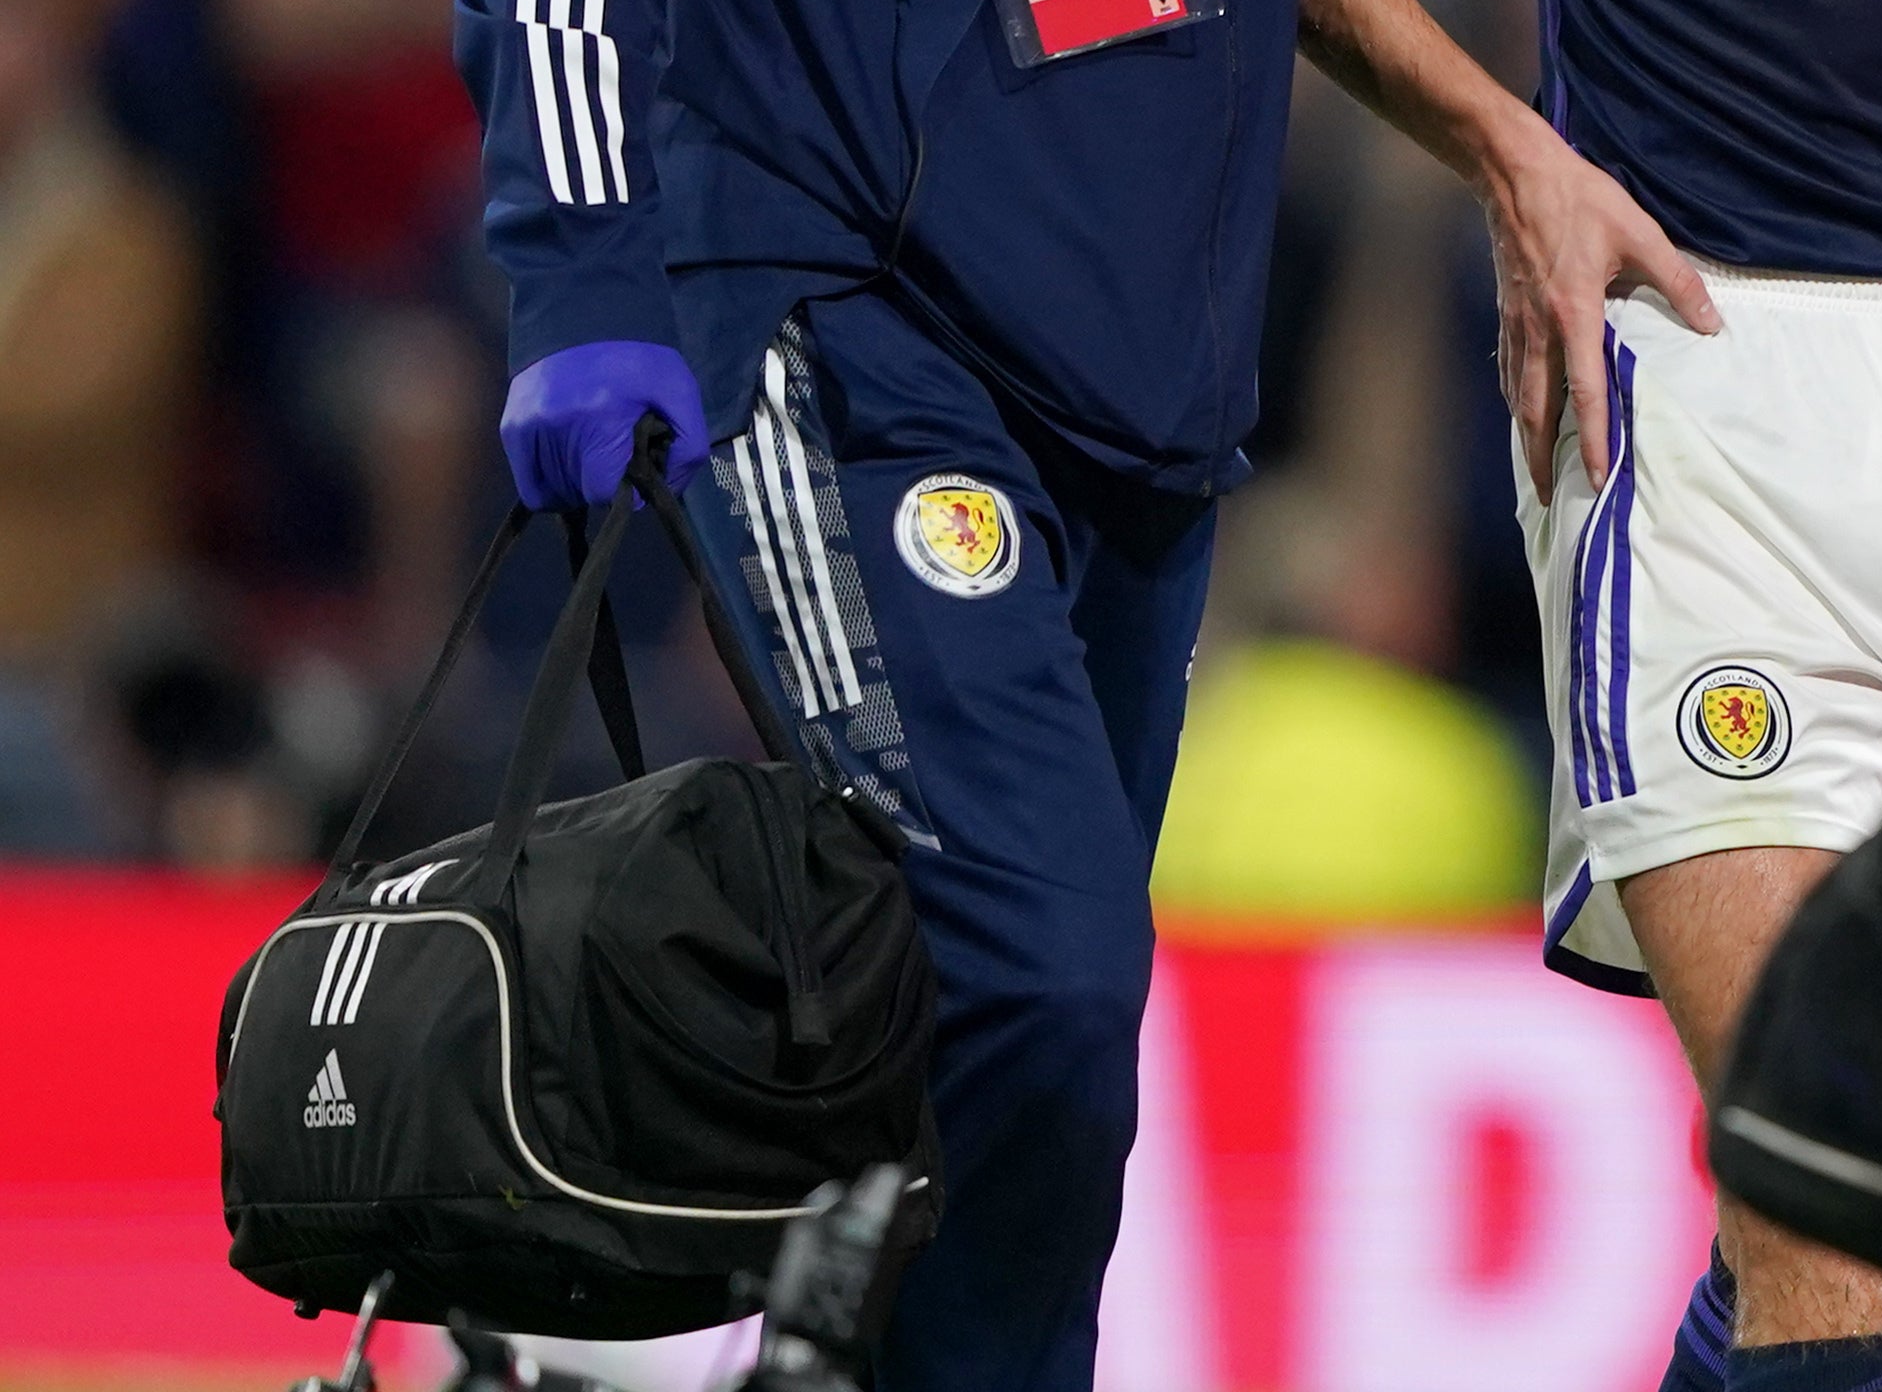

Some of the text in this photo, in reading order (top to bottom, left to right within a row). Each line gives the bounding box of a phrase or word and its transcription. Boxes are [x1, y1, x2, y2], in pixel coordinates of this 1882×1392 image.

[922, 475, 982, 490] SCOTLAND
[924, 569, 942, 584] EST
[1707, 674, 1759, 688] SCOTLAND
[1702, 750, 1717, 764] EST
[303, 1099, 357, 1128] adidas
